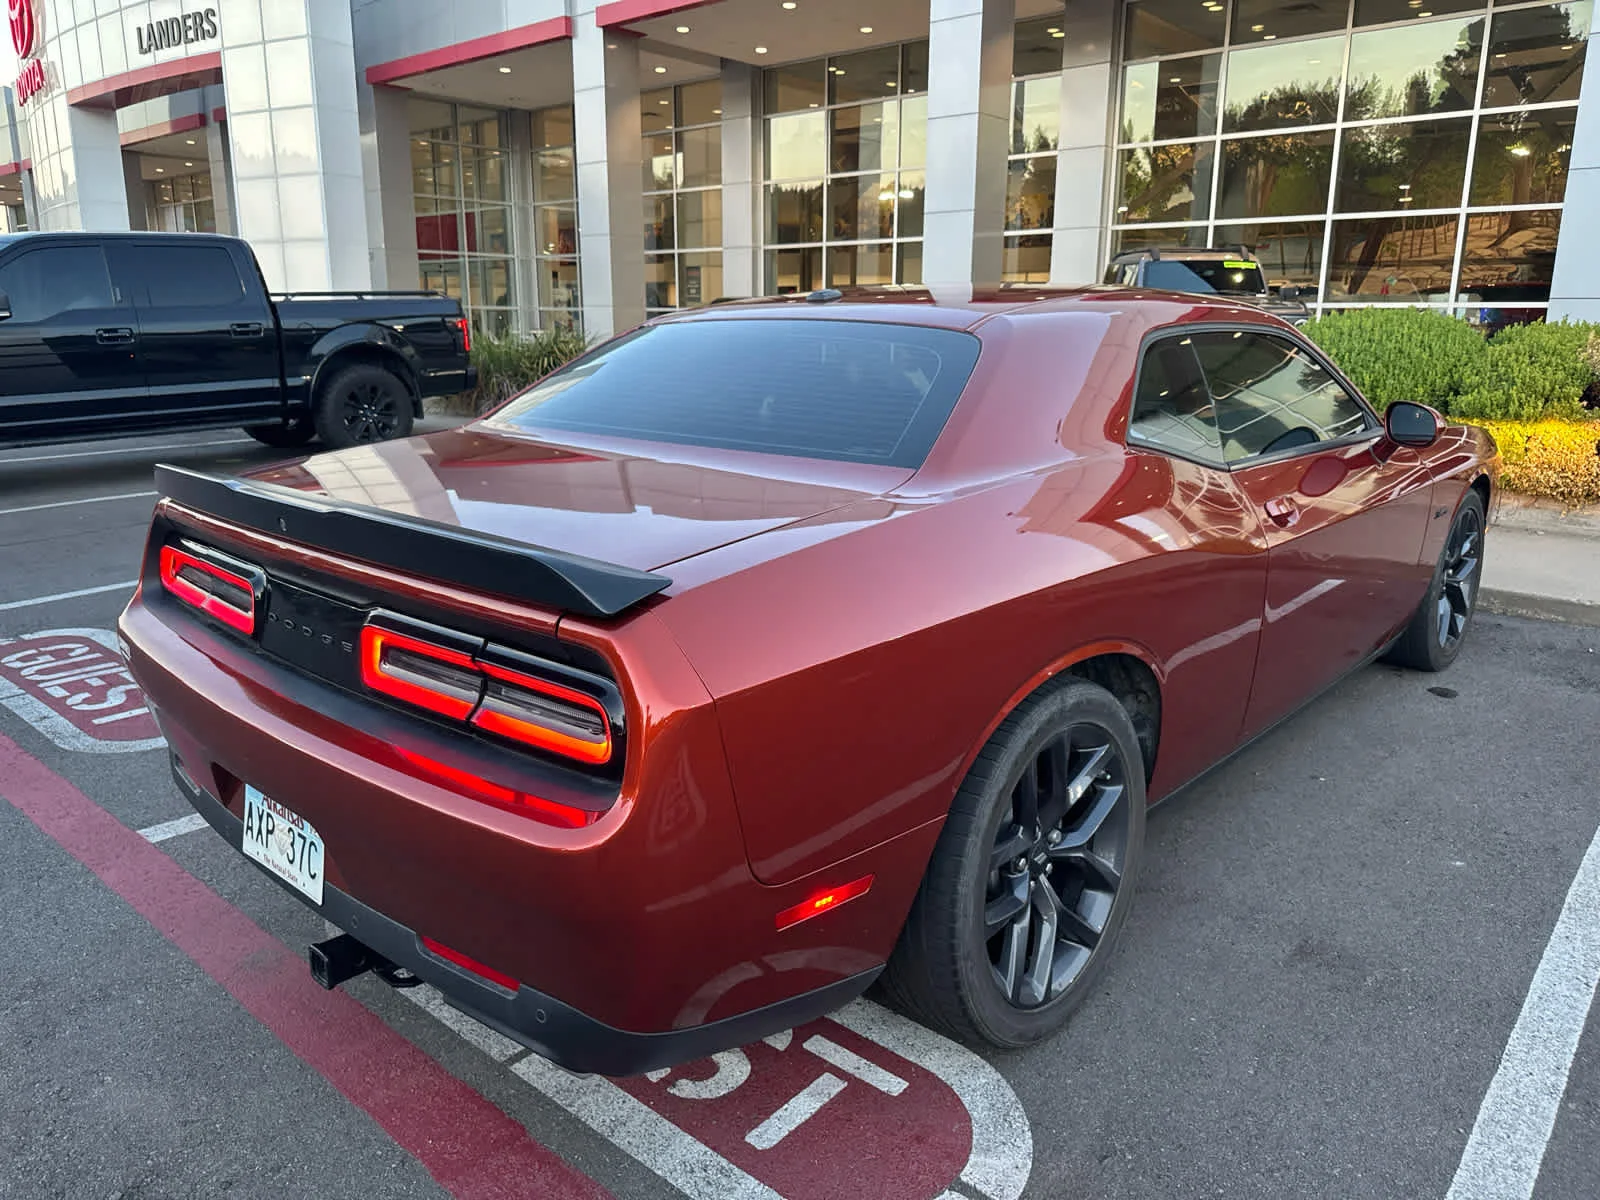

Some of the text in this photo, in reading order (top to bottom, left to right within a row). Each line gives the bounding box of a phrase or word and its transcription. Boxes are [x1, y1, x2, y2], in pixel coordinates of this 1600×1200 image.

[136, 8, 217, 55] LANDERS
[268, 611, 353, 653] DODGE
[245, 801, 318, 880] AXP 37C
